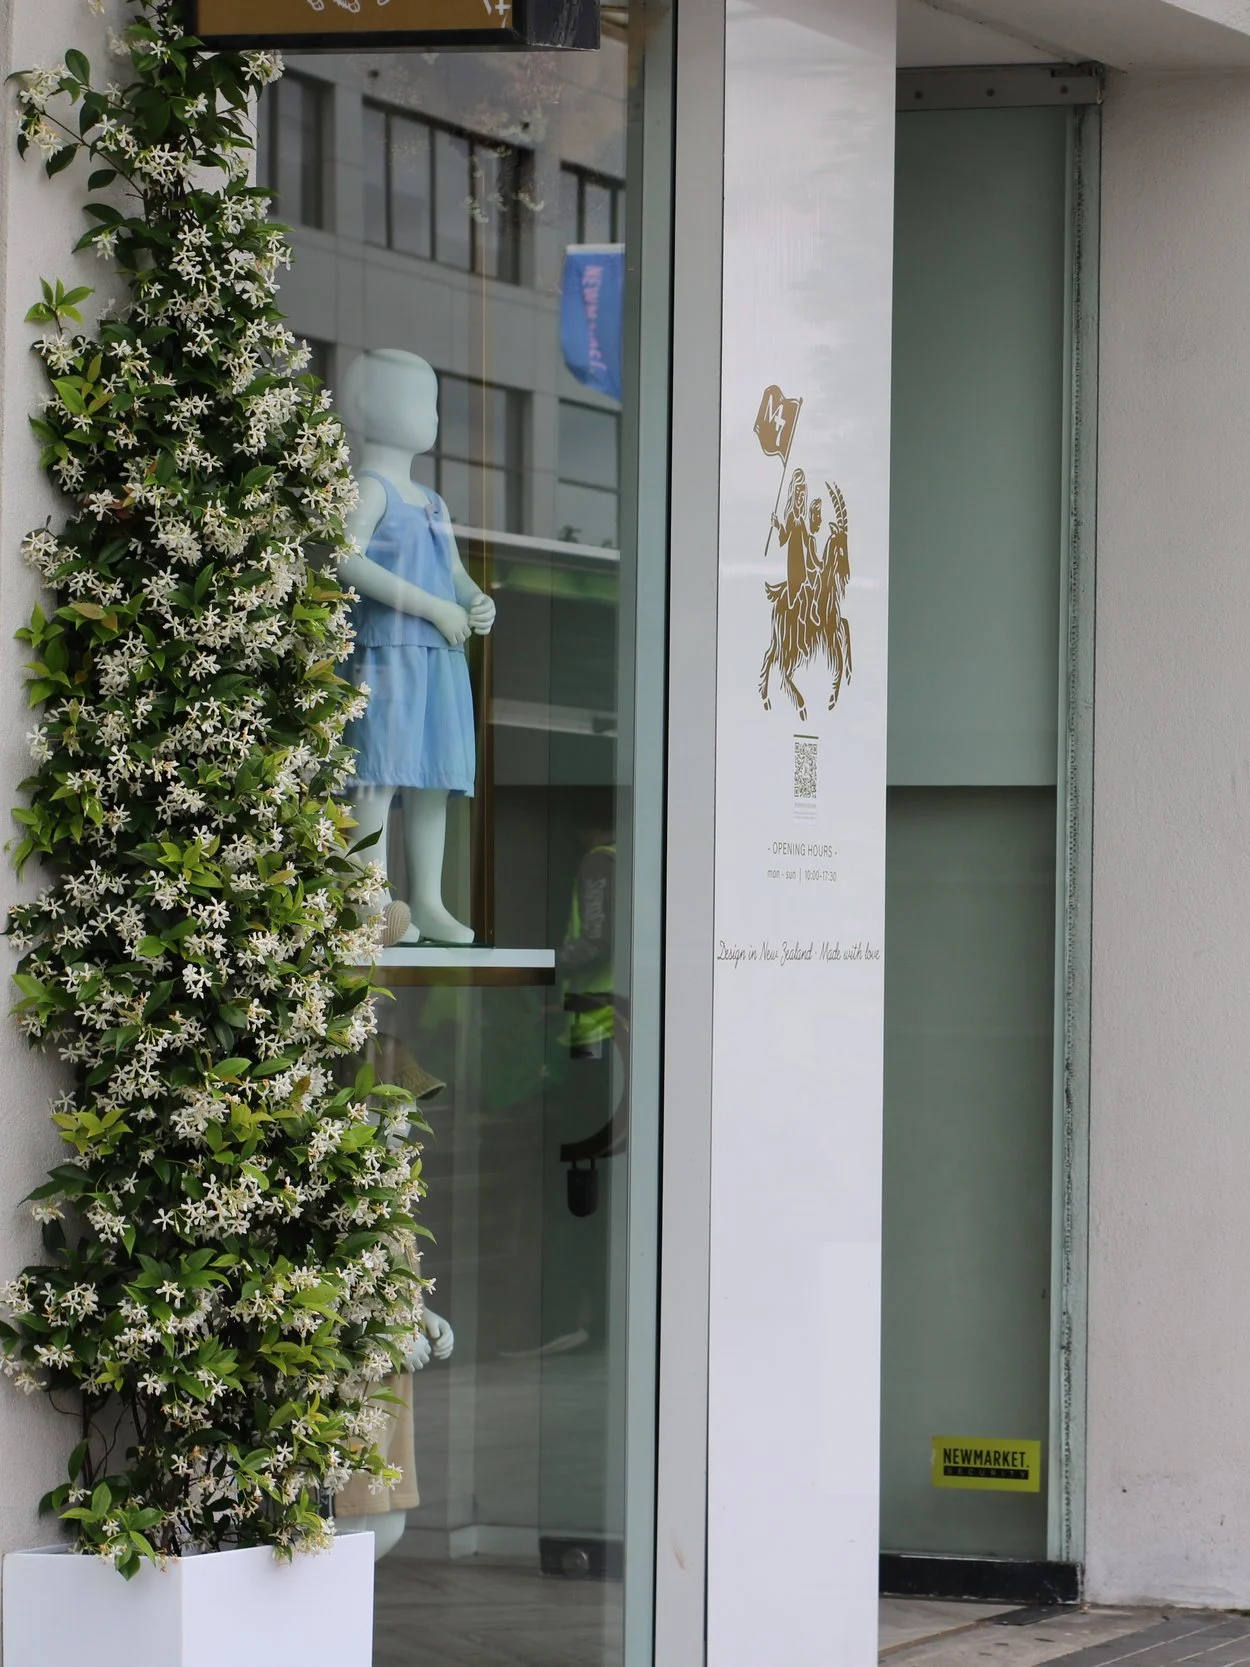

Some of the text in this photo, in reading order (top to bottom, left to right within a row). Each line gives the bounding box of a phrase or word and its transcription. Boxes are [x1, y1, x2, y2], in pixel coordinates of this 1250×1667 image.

[772, 841, 833, 859] OPENING HOURS
[767, 869, 781, 879] mon
[786, 870, 797, 880] sun
[804, 869, 837, 882] 10:00-17:30
[717, 940, 881, 969] Design in New Zealand Made with love
[943, 1447, 1030, 1469] NEWMARKET.
